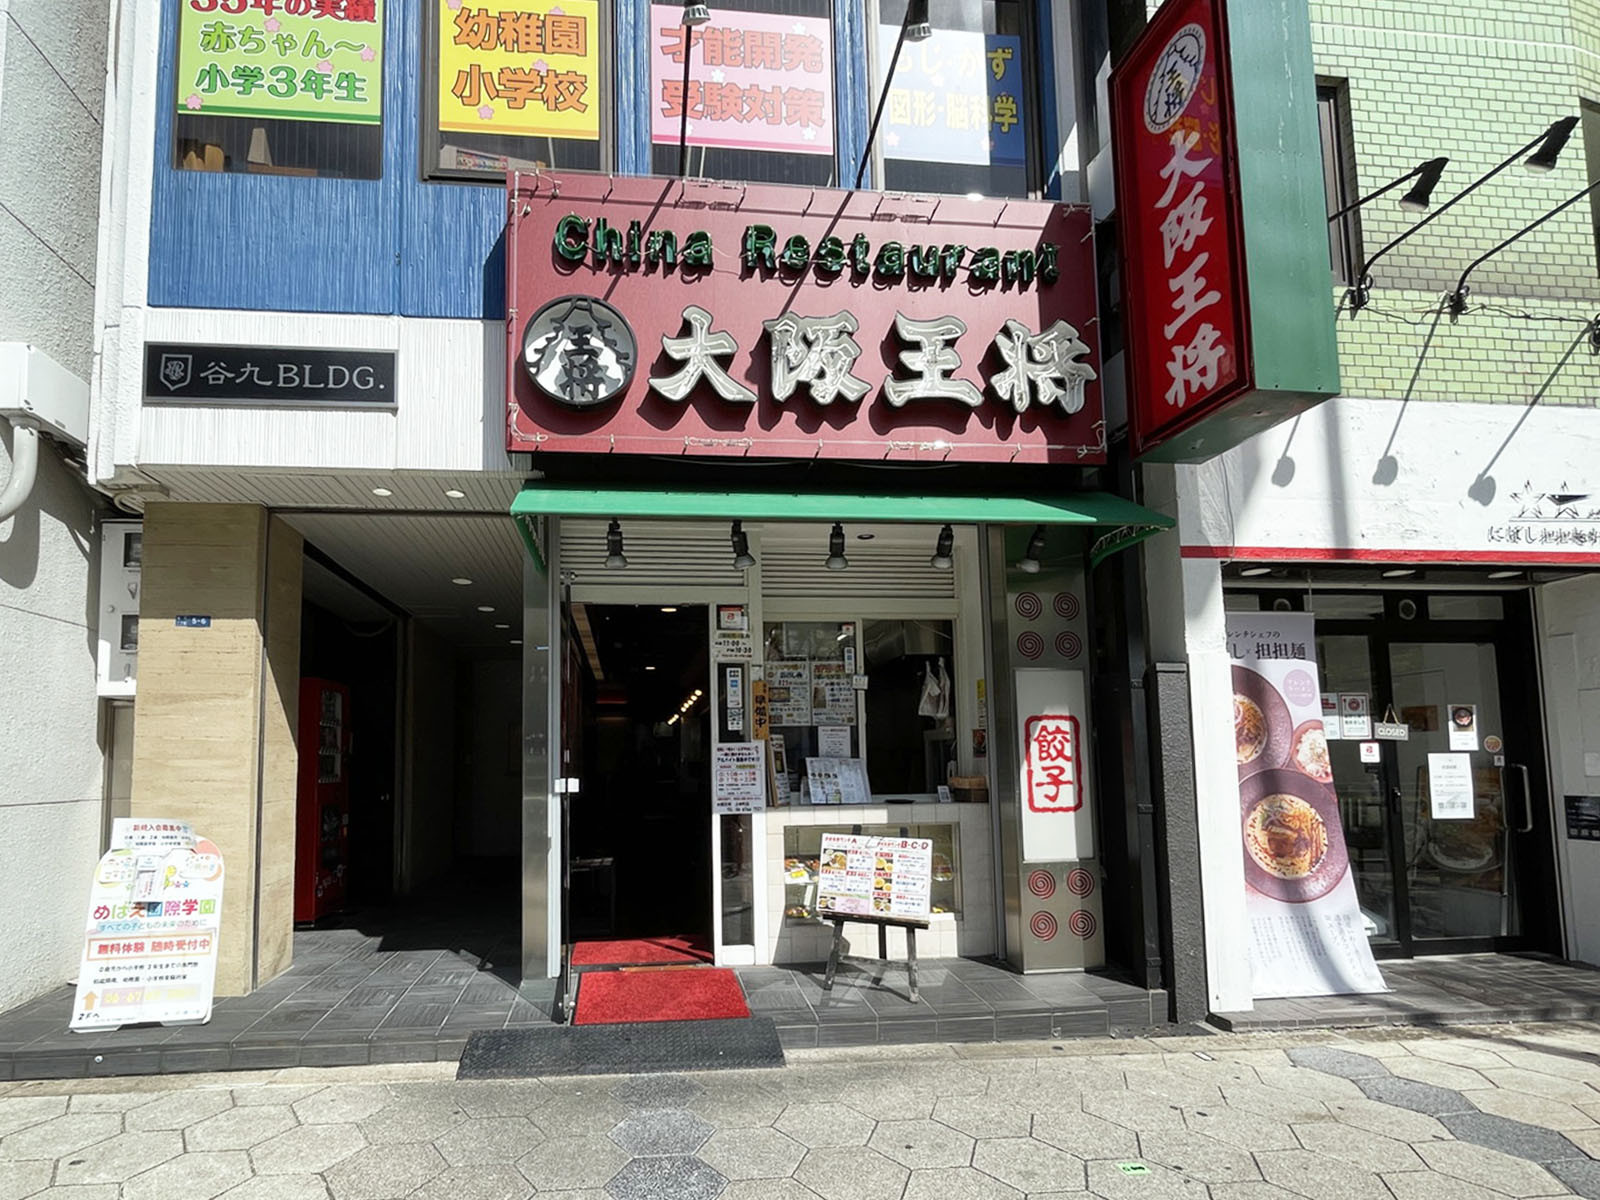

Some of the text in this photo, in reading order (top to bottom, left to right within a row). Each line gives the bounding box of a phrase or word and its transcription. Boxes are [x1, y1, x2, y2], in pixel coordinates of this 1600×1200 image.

[453, 7, 588, 57] 幼稚園
[659, 24, 825, 74] 才能開発
[194, 62, 369, 102] 小学3年生
[453, 62, 588, 114] 小学校
[660, 78, 826, 129] 受験対策
[553, 212, 1062, 285] China Restaurant
[1153, 129, 1225, 409] 大阪王将
[646, 304, 1097, 414] 大阪王将
[1033, 725, 1073, 802] 餃子
